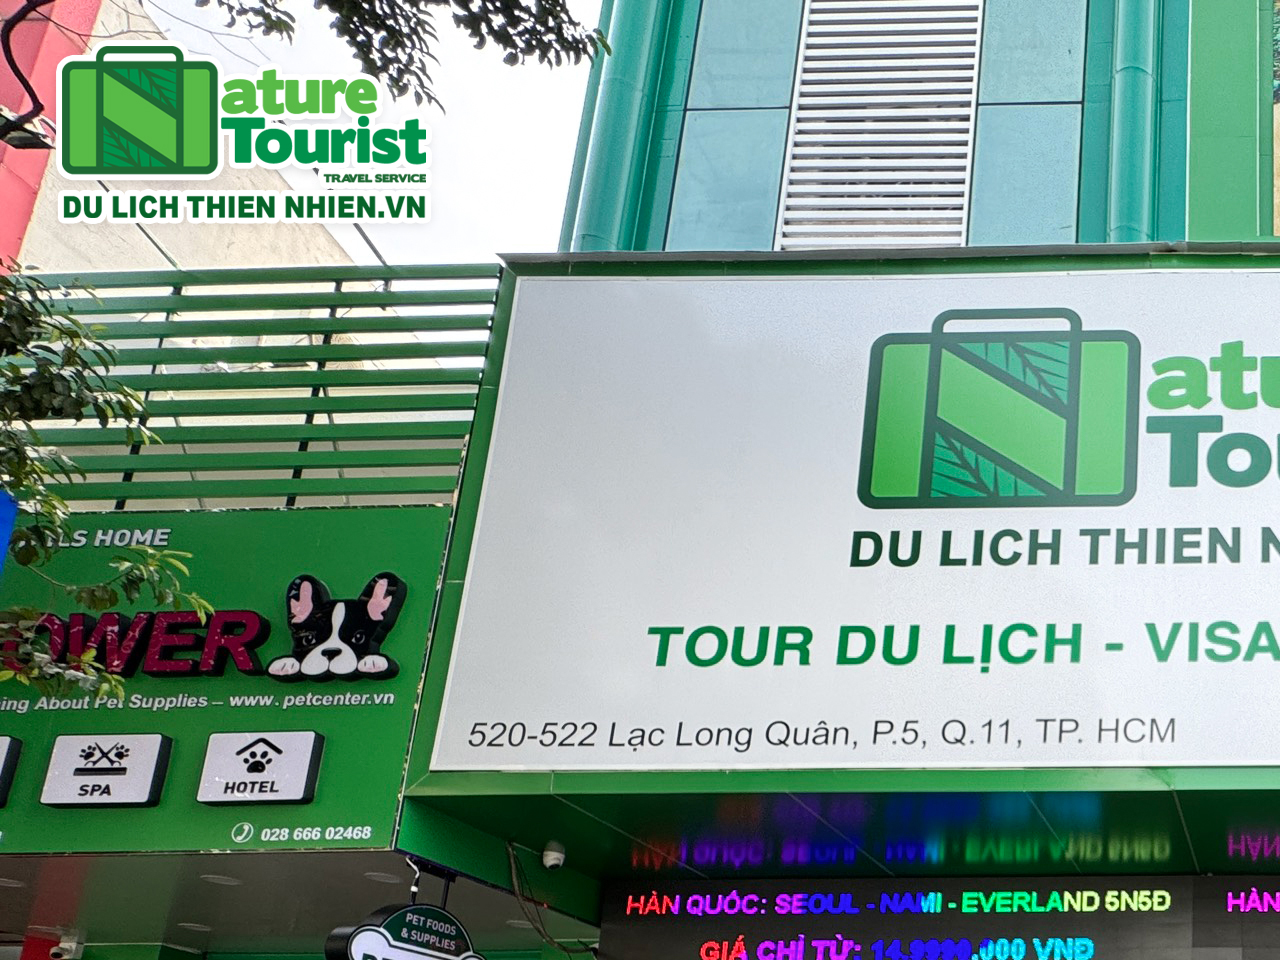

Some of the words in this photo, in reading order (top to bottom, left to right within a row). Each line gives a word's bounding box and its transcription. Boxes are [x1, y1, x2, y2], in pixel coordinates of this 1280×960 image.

[94, 529, 171, 547] HOME
[849, 529, 923, 568] DU
[938, 528, 1062, 567] LICH
[1079, 526, 1242, 565] THIEN
[646, 625, 813, 668] TOUR
[836, 624, 920, 666] DU
[942, 622, 1083, 674] LỊCH
[34, 694, 90, 711] About
[129, 694, 208, 711] Supplies
[468, 721, 597, 748] 520-522
[609, 720, 665, 754] Lạc
[675, 720, 753, 753] Long
[764, 718, 858, 751] Quân,
[872, 719, 927, 749] P.5,
[941, 718, 1022, 749] Q.11,
[1035, 718, 1083, 744] TP.
[1097, 717, 1176, 744] HCM
[78, 784, 112, 797] SPA
[223, 781, 280, 795] HOTEL
[261, 828, 291, 841] 028
[293, 827, 321, 841] 666
[325, 826, 372, 840] 02468
[626, 891, 680, 915] HÀN
[686, 889, 767, 916] QUỐC:
[774, 892, 858, 915] SEOUL
[880, 891, 943, 914] NAMI
[961, 891, 1100, 914] EVERLAND
[1104, 890, 1171, 912] 5N5Đ
[1226, 888, 1280, 913] HÀN
[405, 912, 426, 925] PET
[426, 918, 457, 936] FOODS
[400, 927, 408, 939] &
[410, 929, 456, 951] SUPPLIES
